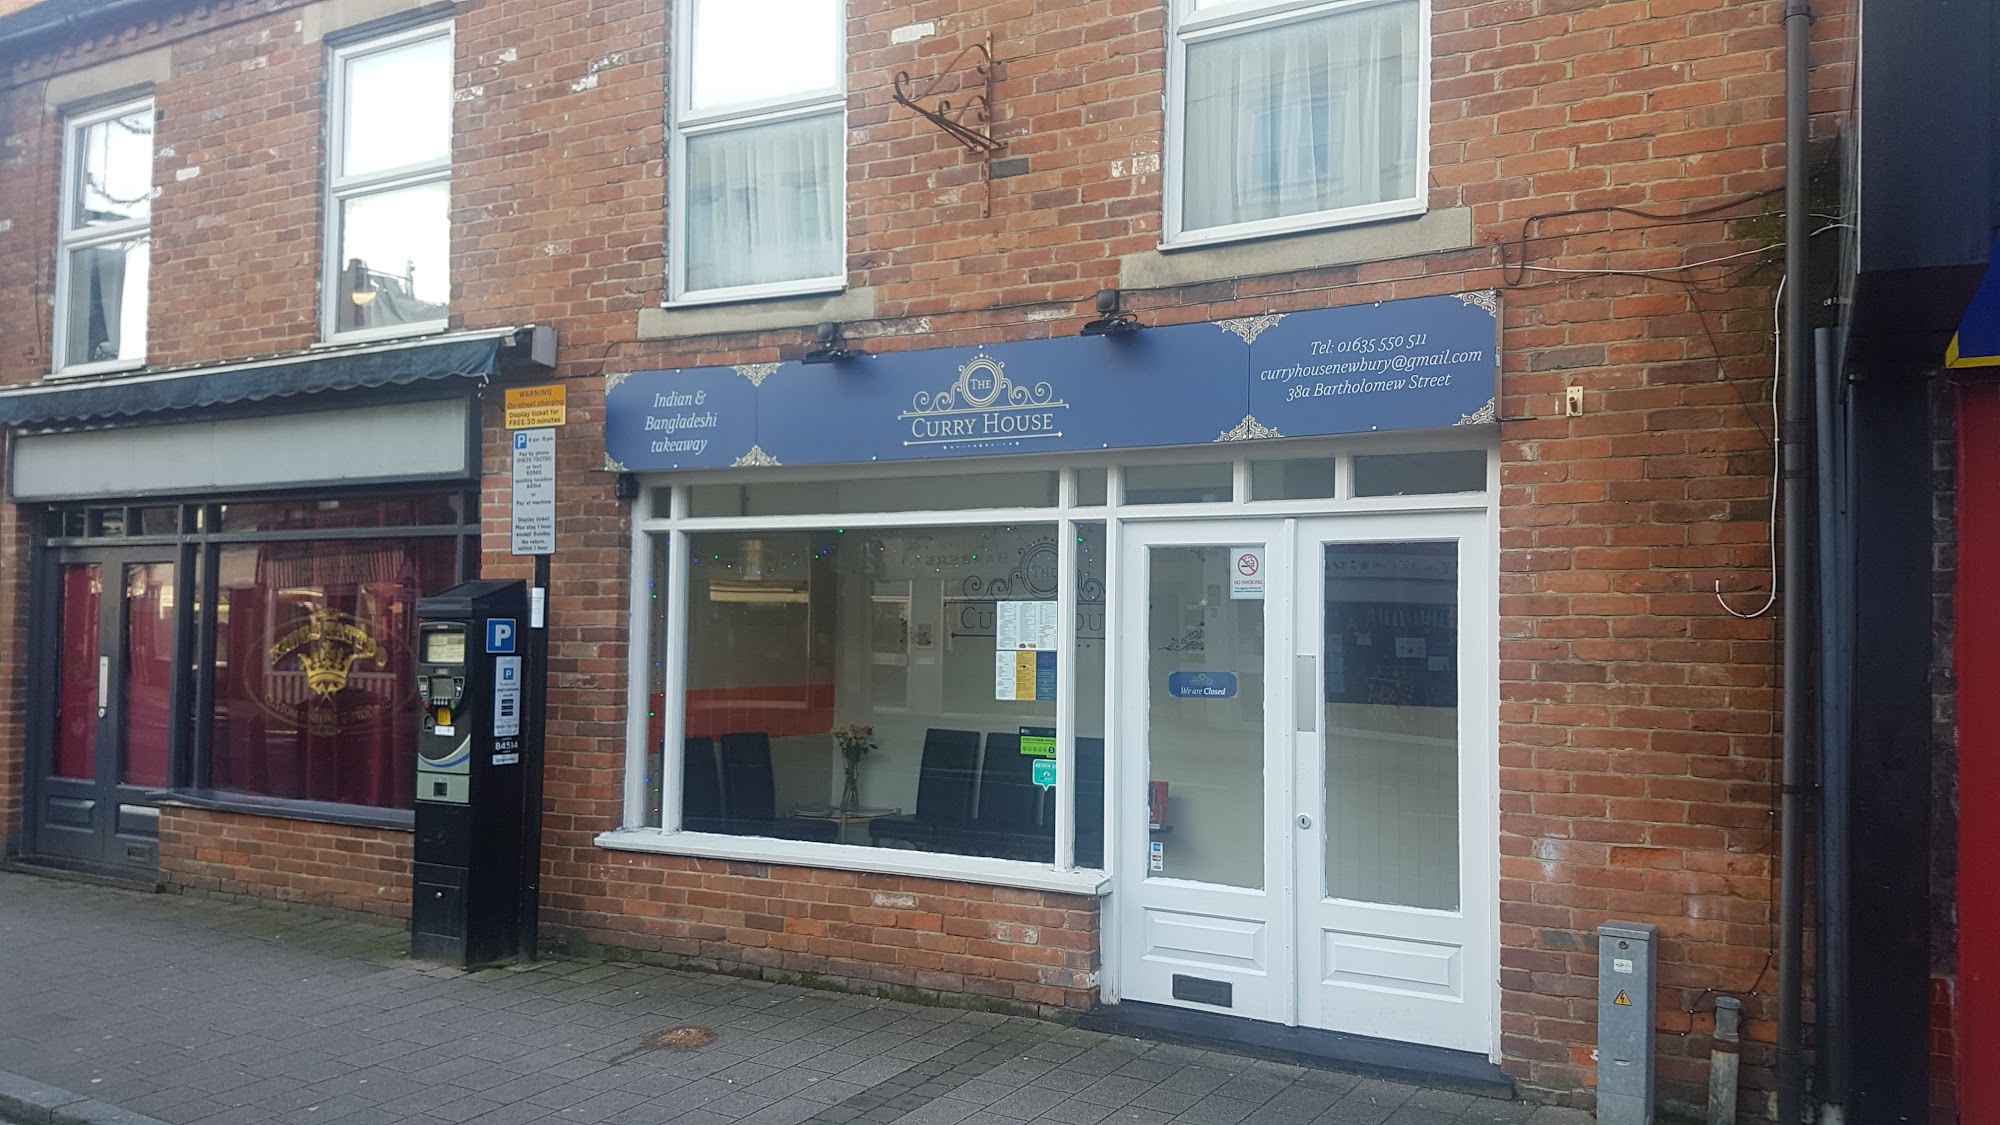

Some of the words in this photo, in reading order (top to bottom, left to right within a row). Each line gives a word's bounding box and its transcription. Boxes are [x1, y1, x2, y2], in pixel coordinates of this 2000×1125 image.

[1310, 340, 1335, 355] Tel:
[1337, 338, 1375, 354] 01635
[1380, 336, 1404, 351] 550
[1406, 333, 1427, 348] 511
[1260, 349, 1483, 382] curryhousenewbury@gmail.com
[519, 388, 552, 398] WARNING
[969, 378, 992, 390] THE
[1285, 385, 1310, 402] 38a
[1313, 376, 1406, 397] Bartholomew
[1408, 373, 1452, 389] Street
[537, 399, 564, 407] charging
[653, 391, 693, 408] Indian
[695, 390, 707, 405] &
[508, 419, 525, 427] FREE
[644, 411, 718, 434] Bangladeshi
[911, 417, 977, 438] CURRY
[982, 412, 1054, 434] HOUSE
[651, 436, 708, 456] takeaway
[1180, 686, 1190, 695] We
[1203, 687, 1226, 696] Closed
[495, 741, 518, 751] 84514
